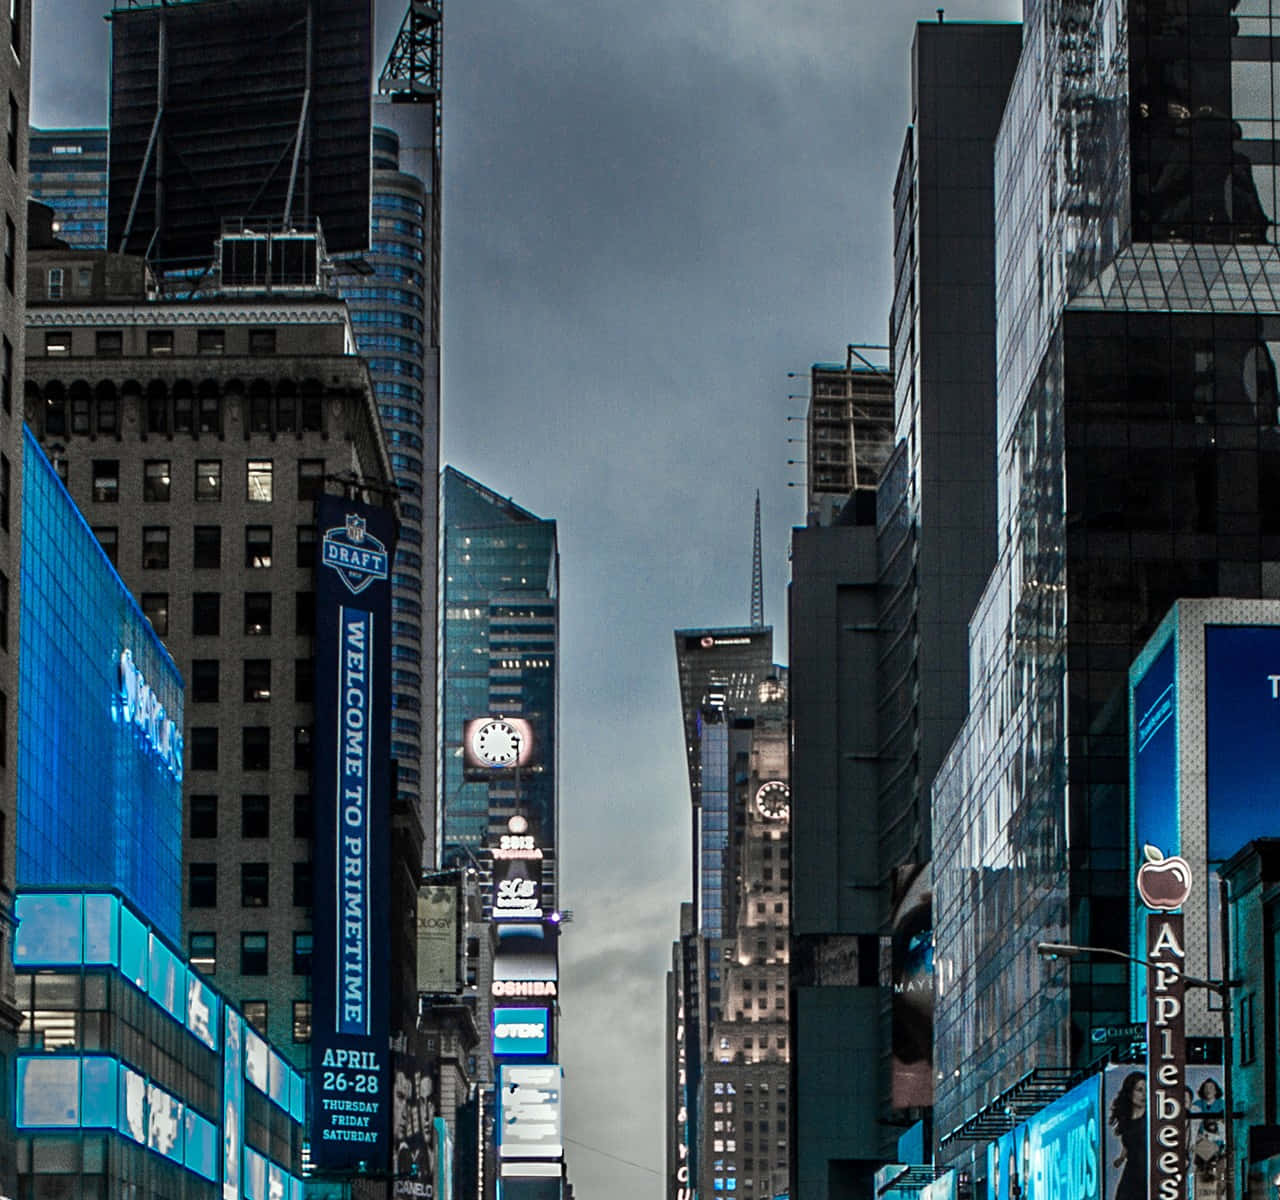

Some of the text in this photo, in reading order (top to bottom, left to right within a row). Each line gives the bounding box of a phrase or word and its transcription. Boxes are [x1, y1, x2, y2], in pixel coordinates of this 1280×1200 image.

[328, 544, 382, 570] DRAFT
[343, 620, 365, 1025] WELCOME TO PRIMETIME
[322, 1047, 380, 1071] APRIL
[323, 1072, 379, 1094] 26-28
[322, 1099, 380, 1114] THURSDAY
[331, 1115, 370, 1128] FRIDAY
[322, 1128, 378, 1143] SATURDAY
